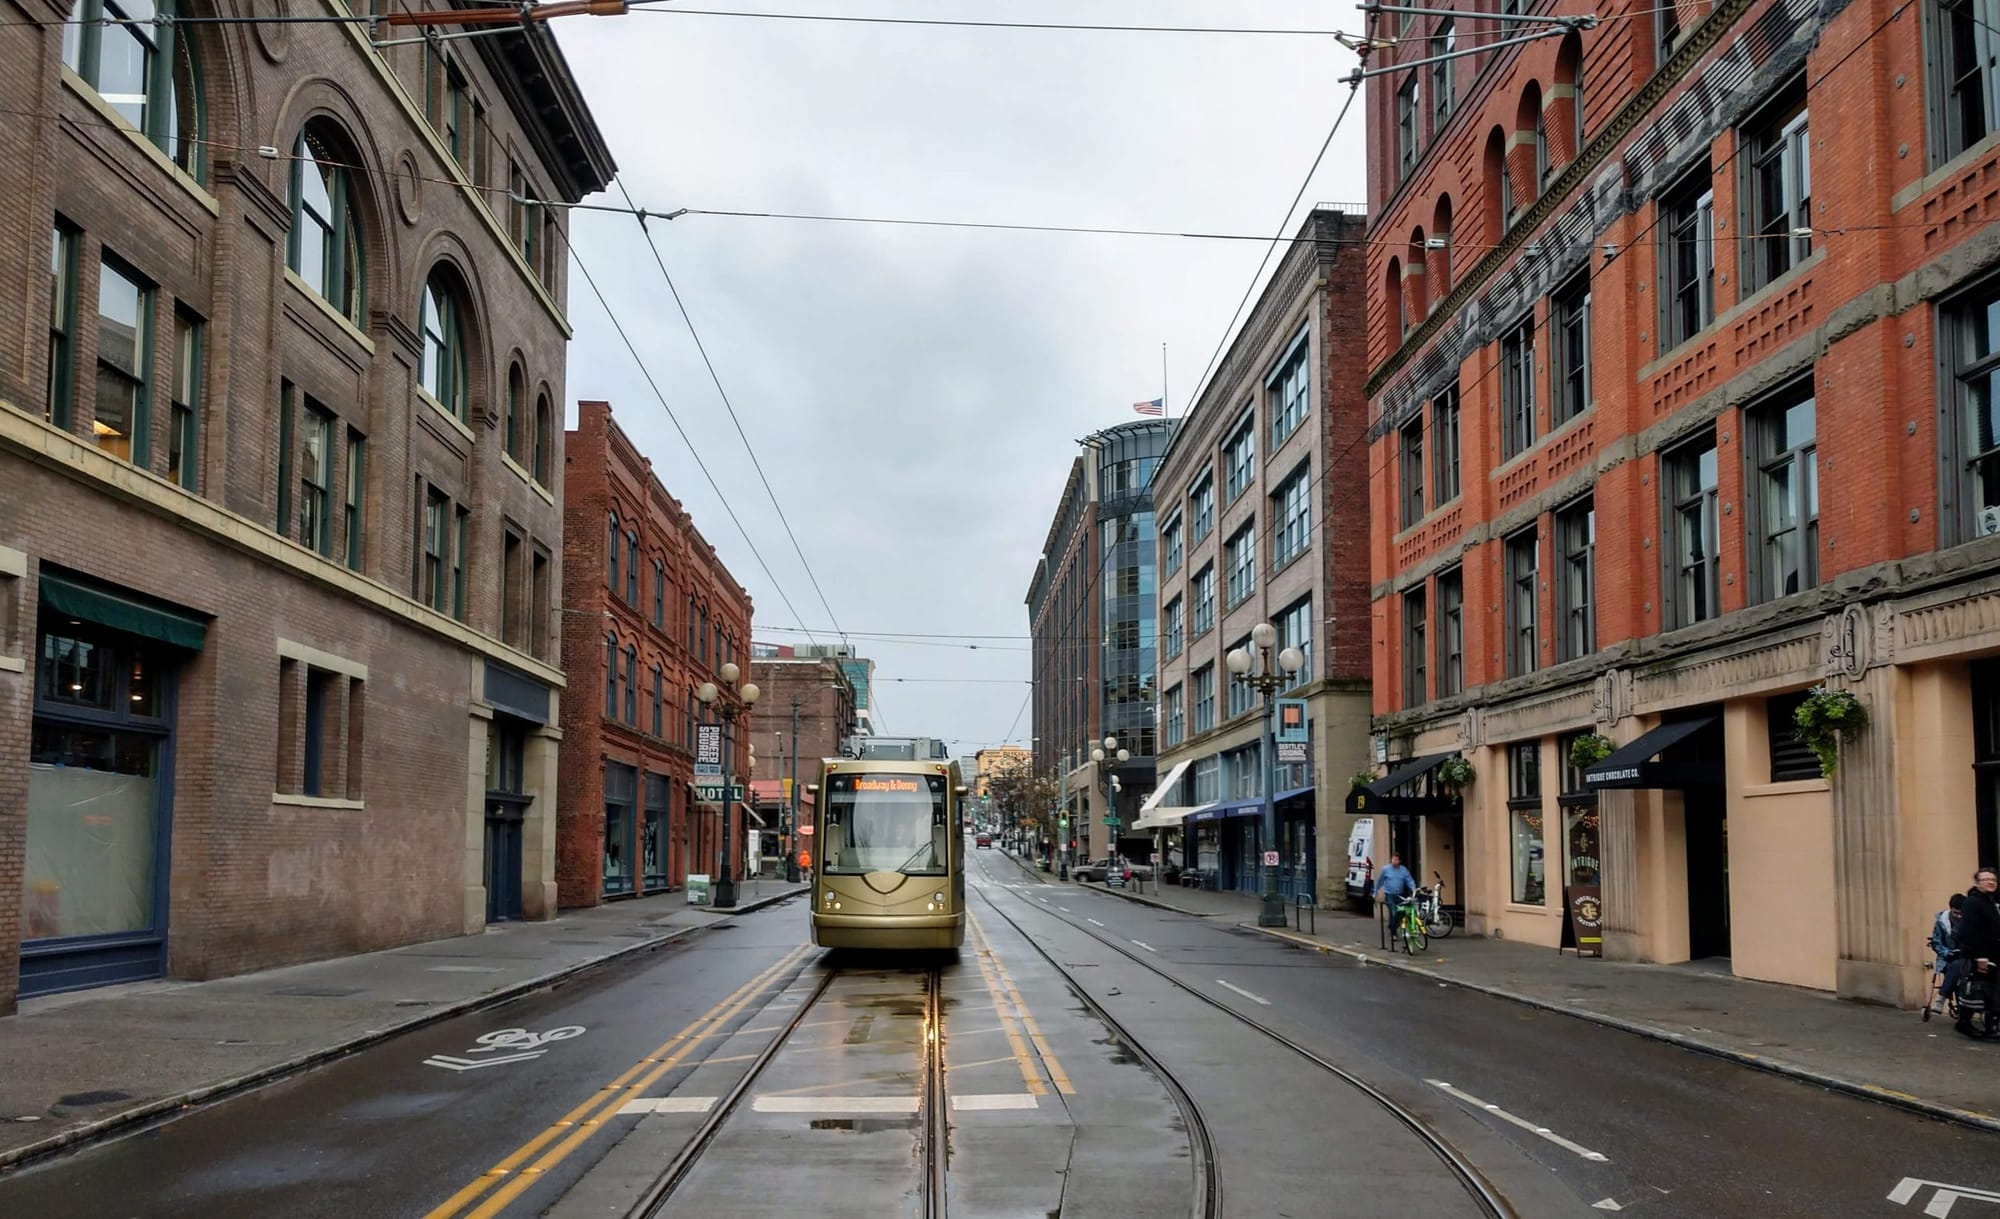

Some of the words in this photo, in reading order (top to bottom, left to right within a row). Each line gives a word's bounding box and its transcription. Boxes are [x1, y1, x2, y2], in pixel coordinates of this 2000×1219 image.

[709, 726, 720, 763] PIONEER
[1606, 770, 1631, 781] CHOCOLATE
[1631, 768, 1640, 778] CO.
